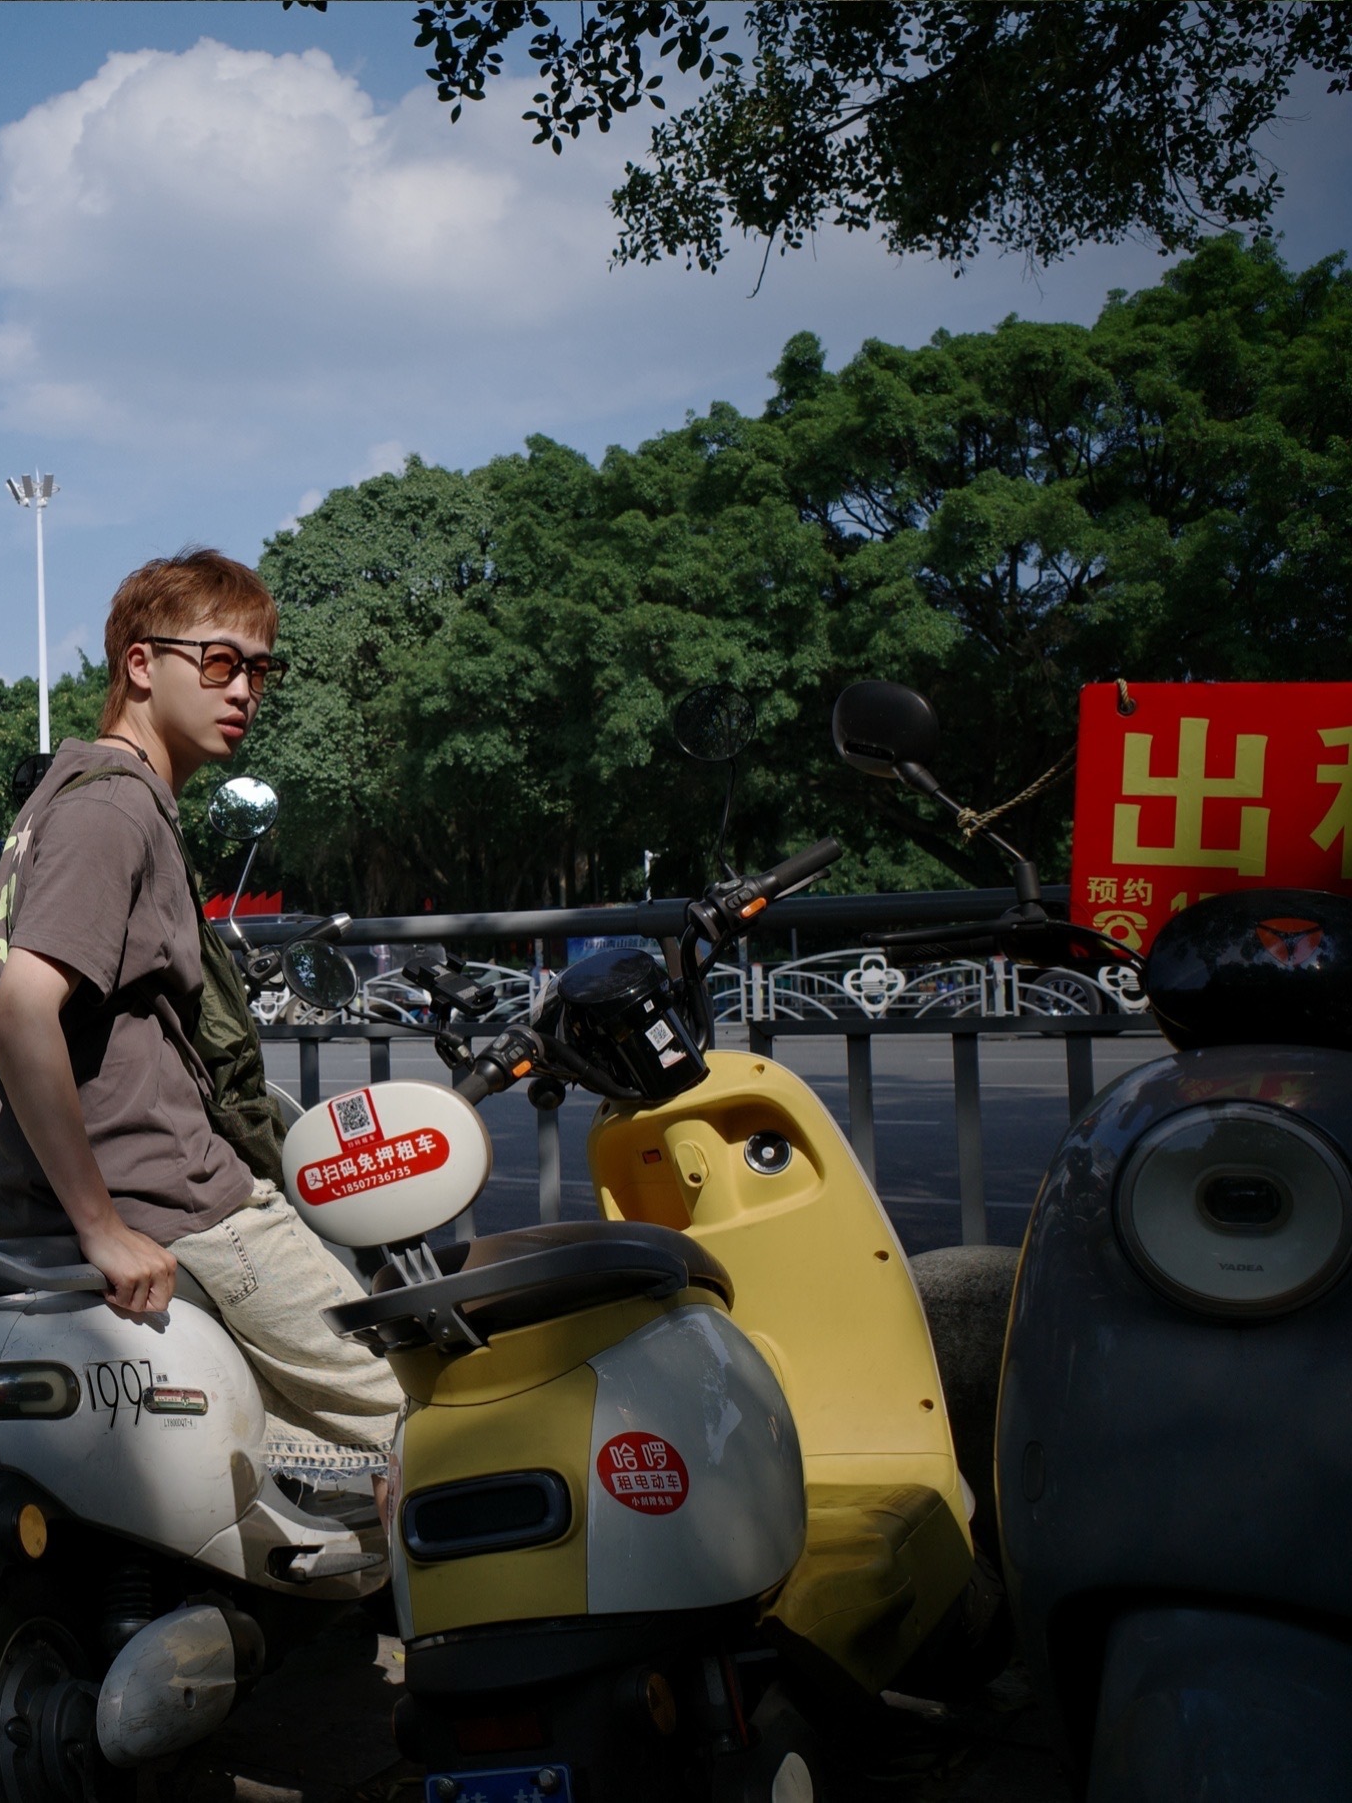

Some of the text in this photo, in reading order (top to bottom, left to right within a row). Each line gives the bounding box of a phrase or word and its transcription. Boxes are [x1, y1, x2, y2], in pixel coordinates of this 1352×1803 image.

[1111, 716, 1352, 880] 出
[1087, 876, 1153, 906] 预约
[322, 1133, 437, 1185] 扫码免押租车
[341, 1165, 411, 1195] 18507736735
[1218, 1262, 1265, 1272] YADEA
[609, 1441, 668, 1470] 哈啰
[617, 1474, 680, 1490] 租电动车
